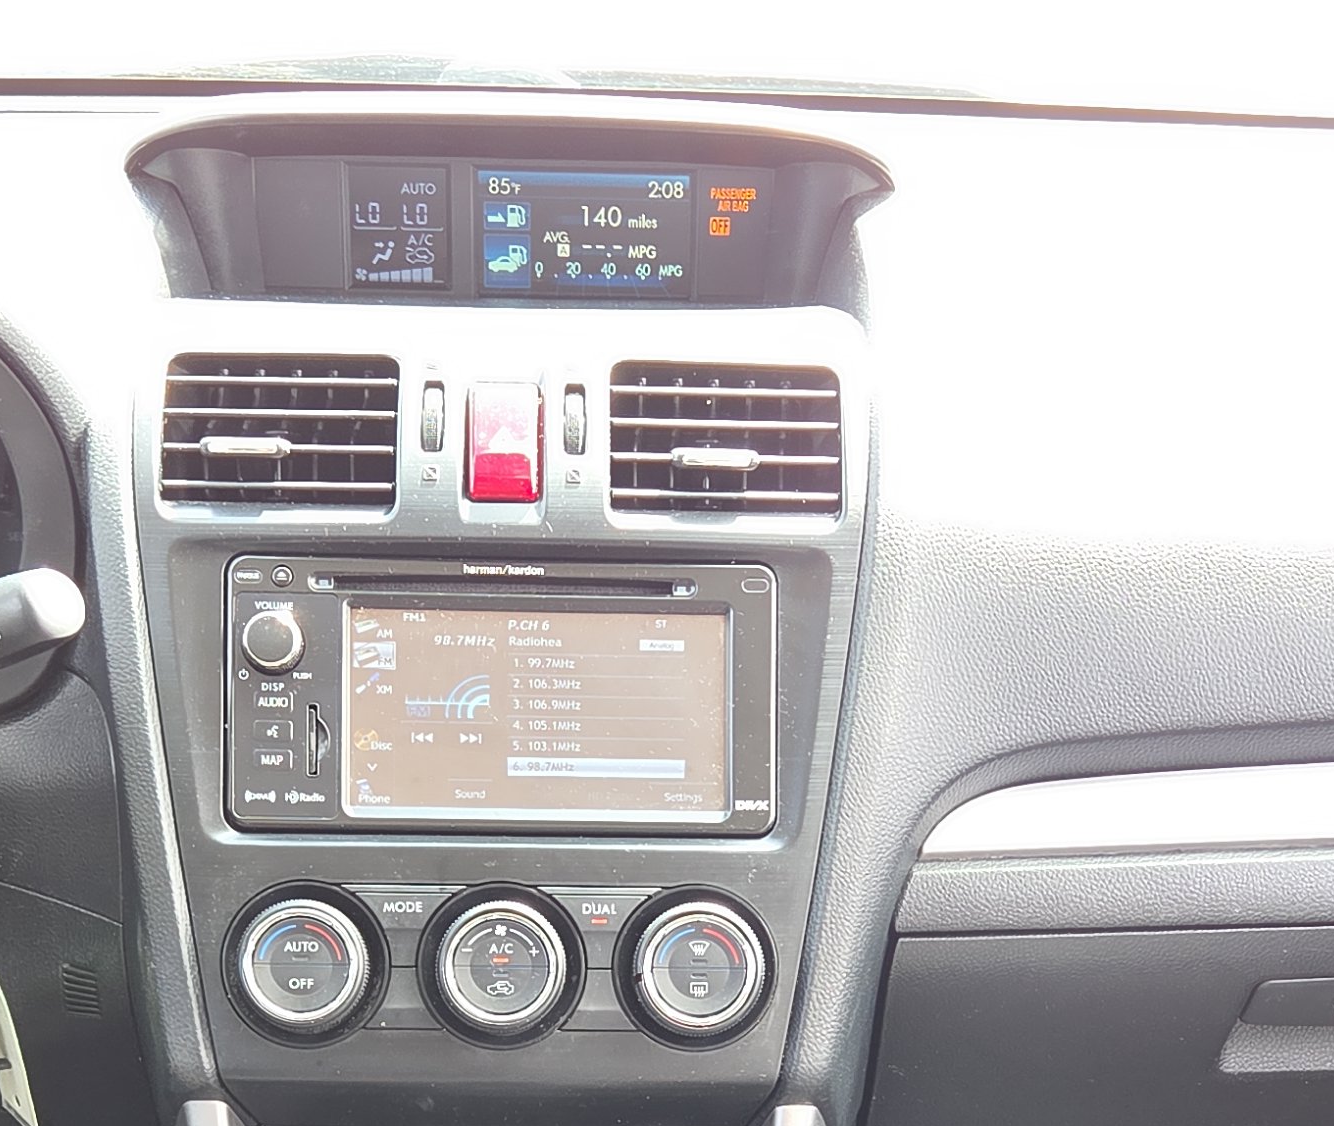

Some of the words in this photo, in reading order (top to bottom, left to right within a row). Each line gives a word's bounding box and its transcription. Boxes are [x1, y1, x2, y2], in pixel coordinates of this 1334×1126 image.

[400, 183, 437, 195] AUTO
[648, 180, 684, 199] 2:08
[581, 205, 622, 227] 140
[628, 213, 658, 229] miles
[711, 218, 729, 234] OFF
[407, 234, 433, 246] A/C
[628, 245, 657, 259] MPG
[566, 261, 581, 275] 20
[601, 263, 616, 276] 40
[635, 264, 651, 277] 60
[658, 264, 683, 277] MPG
[463, 563, 545, 576] harman/kardon
[254, 601, 294, 611] VOLUME
[403, 612, 427, 622] FM1
[508, 619, 539, 631] P.CH
[541, 619, 550, 631] 6
[655, 619, 668, 629] ST
[376, 628, 393, 639] AM
[434, 635, 496, 647] 98.7MHz
[509, 636, 563, 647] Radiohea
[377, 657, 393, 666] FM
[514, 658, 524, 668] 1.
[527, 657, 576, 669] 99.7MHz
[261, 682, 285, 692] DISP
[376, 684, 393, 694] XM
[513, 678, 524, 689] 2.
[528, 678, 582, 690] 106.3MHz
[257, 697, 289, 708] AUDIO
[513, 699, 524, 710] 3.
[528, 699, 582, 711] 106.9MHz
[512, 720, 524, 730] 4.
[528, 720, 582, 731] 105.1MHz
[370, 741, 393, 751] Disc
[512, 740, 524, 751] 5.
[528, 741, 581, 752] 103.1MHz
[260, 755, 284, 765] MAP
[527, 761, 576, 772] 98.7MHz
[300, 792, 326, 802] Radio
[358, 793, 391, 805] Phone
[454, 788, 486, 799] Sound
[663, 792, 703, 804] Settings
[383, 901, 424, 915] MODE
[581, 902, 617, 916] DUAL
[284, 941, 319, 953] AUTO
[489, 943, 514, 956] A/C
[288, 977, 315, 990] OFF
